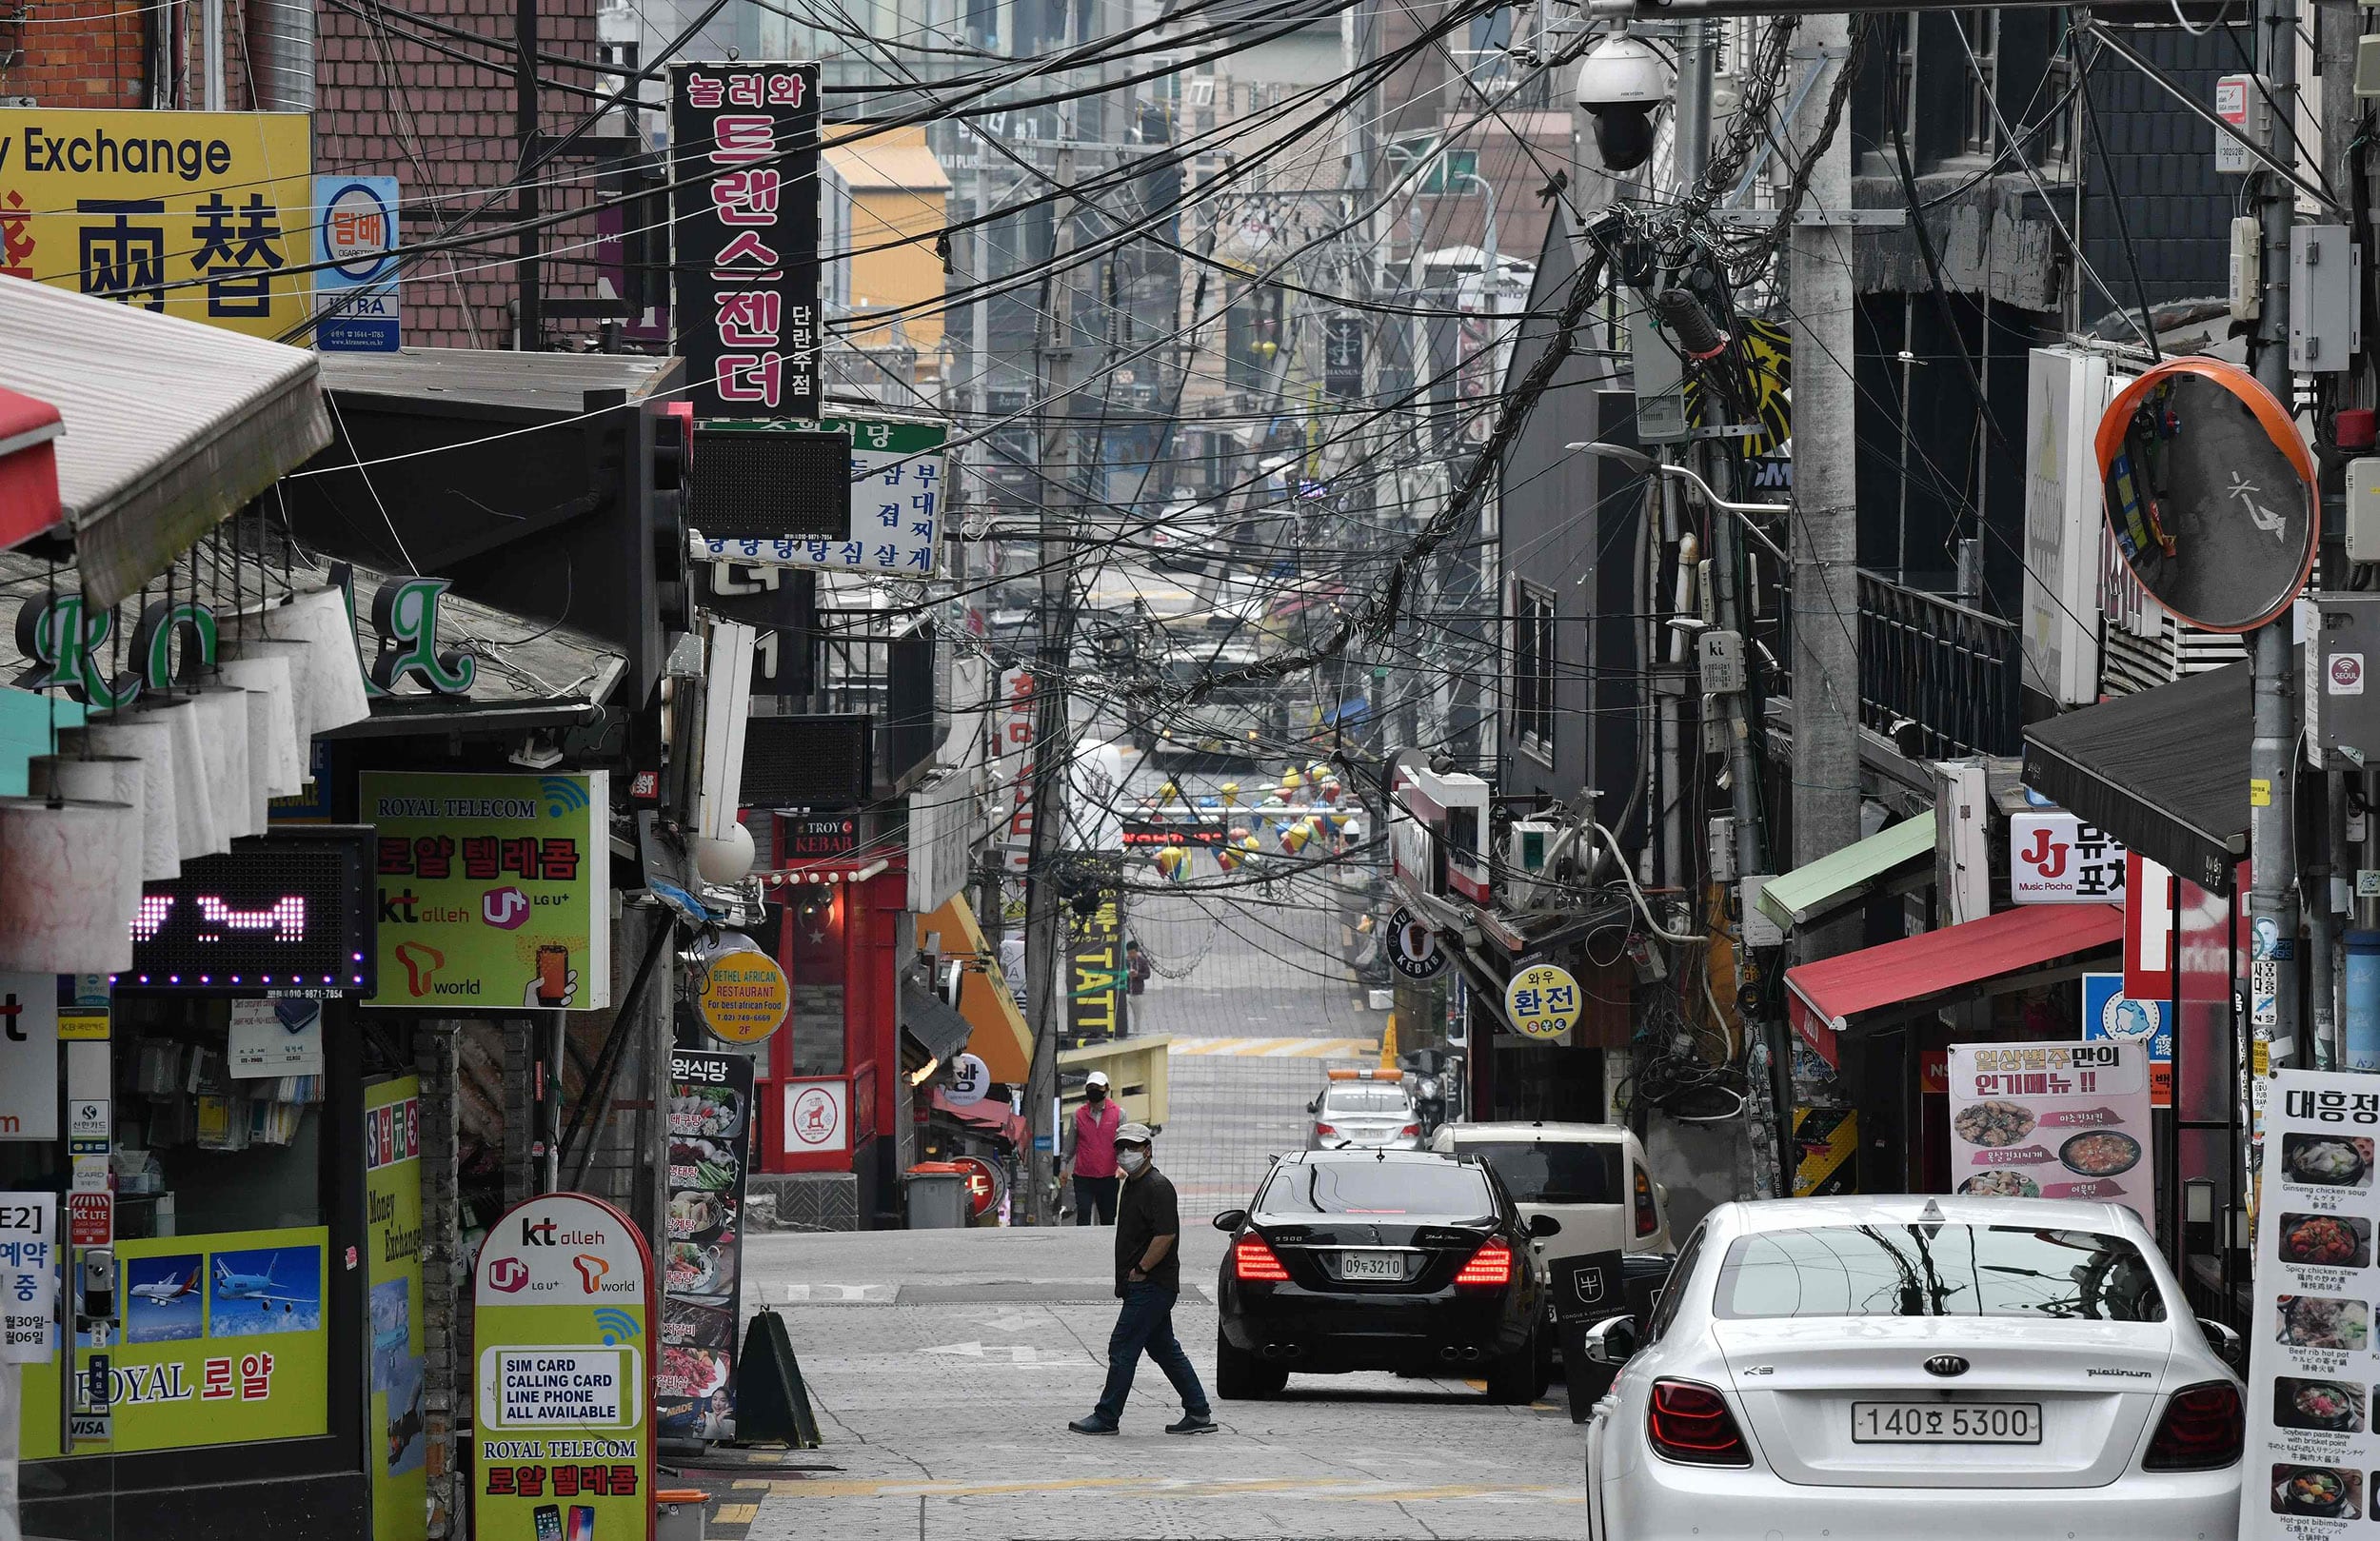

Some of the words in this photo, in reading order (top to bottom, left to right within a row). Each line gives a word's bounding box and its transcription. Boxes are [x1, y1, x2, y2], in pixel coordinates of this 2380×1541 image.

[688, 74, 803, 109] 놀러와
[25, 128, 231, 181] Exchange
[334, 211, 380, 247] 담배
[710, 114, 783, 407] 트랜스젠더
[792, 305, 812, 396] 단란주점
[377, 799, 442, 820] ROYAL
[444, 800, 537, 820] TELECOM
[806, 821, 841, 834] TROY
[795, 836, 854, 853] KEBAB
[2074, 822, 2127, 859] 뮤
[377, 835, 456, 879] 로얄
[462, 835, 580, 880] 텔레콤
[2018, 882, 2043, 891] Music
[2045, 882, 2073, 891] Pocha
[378, 888, 420, 923] kt
[534, 895, 550, 905] LG
[1396, 953, 1440, 975] KEBAB
[713, 970, 741, 982] BETHEL
[744, 971, 777, 983] AFRICAN
[1527, 970, 1555, 986] 와우
[289, 990, 343, 998] 010-9871-7854
[434, 978, 481, 996] world
[717, 986, 775, 998] RESTAURANT
[707, 999, 720, 1009] For
[721, 1000, 737, 1009] best
[764, 1001, 782, 1010] Food
[1514, 985, 1575, 1017] 환전
[738, 1025, 751, 1036] 2F
[1973, 1046, 2120, 1072] 일상별주만의
[671, 1057, 729, 1083] 원식당
[1974, 1072, 2073, 1096] 인기메뉴
[2286, 1090, 2380, 1125] 대흥정
[72, 1119, 107, 1131] 신한카드
[2282, 1183, 2314, 1195] Ginseng
[2315, 1187, 2347, 1195] chicken
[72, 1207, 88, 1220] kt
[89, 1210, 108, 1221] LTE
[368, 1189, 395, 1228] Money
[522, 1217, 557, 1247] kt
[385, 1223, 422, 1264] Exchange
[1345, 1259, 1400, 1274] 09두3210
[2285, 1264, 2307, 1274] Spicy
[2308, 1267, 2338, 1275] chicken
[13, 1274, 38, 1302] 중
[532, 1282, 545, 1291] LG
[601, 1280, 635, 1293] world
[2289, 1347, 2307, 1355] Beef
[506, 1360, 532, 1372] SIM
[537, 1359, 576, 1372] CARD
[1931, 1358, 1961, 1373] KIA
[202, 1353, 274, 1400] 로얄
[506, 1375, 569, 1388] CALLING
[573, 1374, 612, 1387] CARD
[2086, 1368, 2152, 1379] platinum
[506, 1392, 540, 1403] LINE
[544, 1391, 593, 1403] PHONE
[506, 1407, 534, 1419] ALL
[537, 1406, 616, 1418] AVAILABLE
[71, 1420, 106, 1435] VISA
[1867, 1409, 1944, 1435] 140호
[1952, 1409, 2029, 1436] 5300
[2282, 1428, 2311, 1437] Soybean
[484, 1441, 545, 1459] ROYAL
[547, 1440, 637, 1458] TELECOM
[2329, 1439, 2348, 1448] point
[486, 1465, 546, 1497] 로얄
[551, 1465, 639, 1496] 텔레콤
[2279, 1515, 2311, 1526] Hot-pot
[2311, 1518, 2349, 1529] bibimbap
